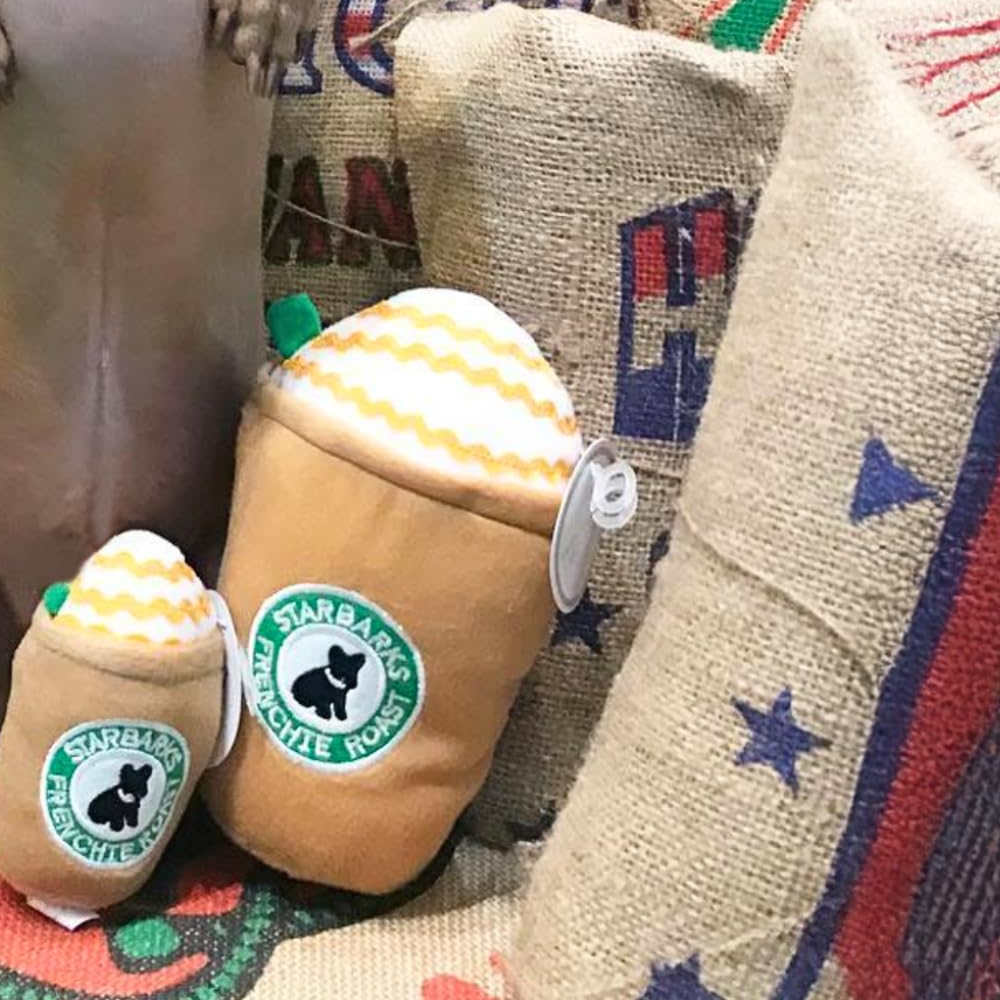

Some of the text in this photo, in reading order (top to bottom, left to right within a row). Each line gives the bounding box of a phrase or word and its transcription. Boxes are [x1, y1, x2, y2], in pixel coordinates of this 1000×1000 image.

[272, 598, 411, 683] STARBARKS
[253, 634, 412, 760] FRENCHIE ROAST
[63, 727, 183, 773] STARBARKS
[47, 773, 136, 863] FRENCHIE
